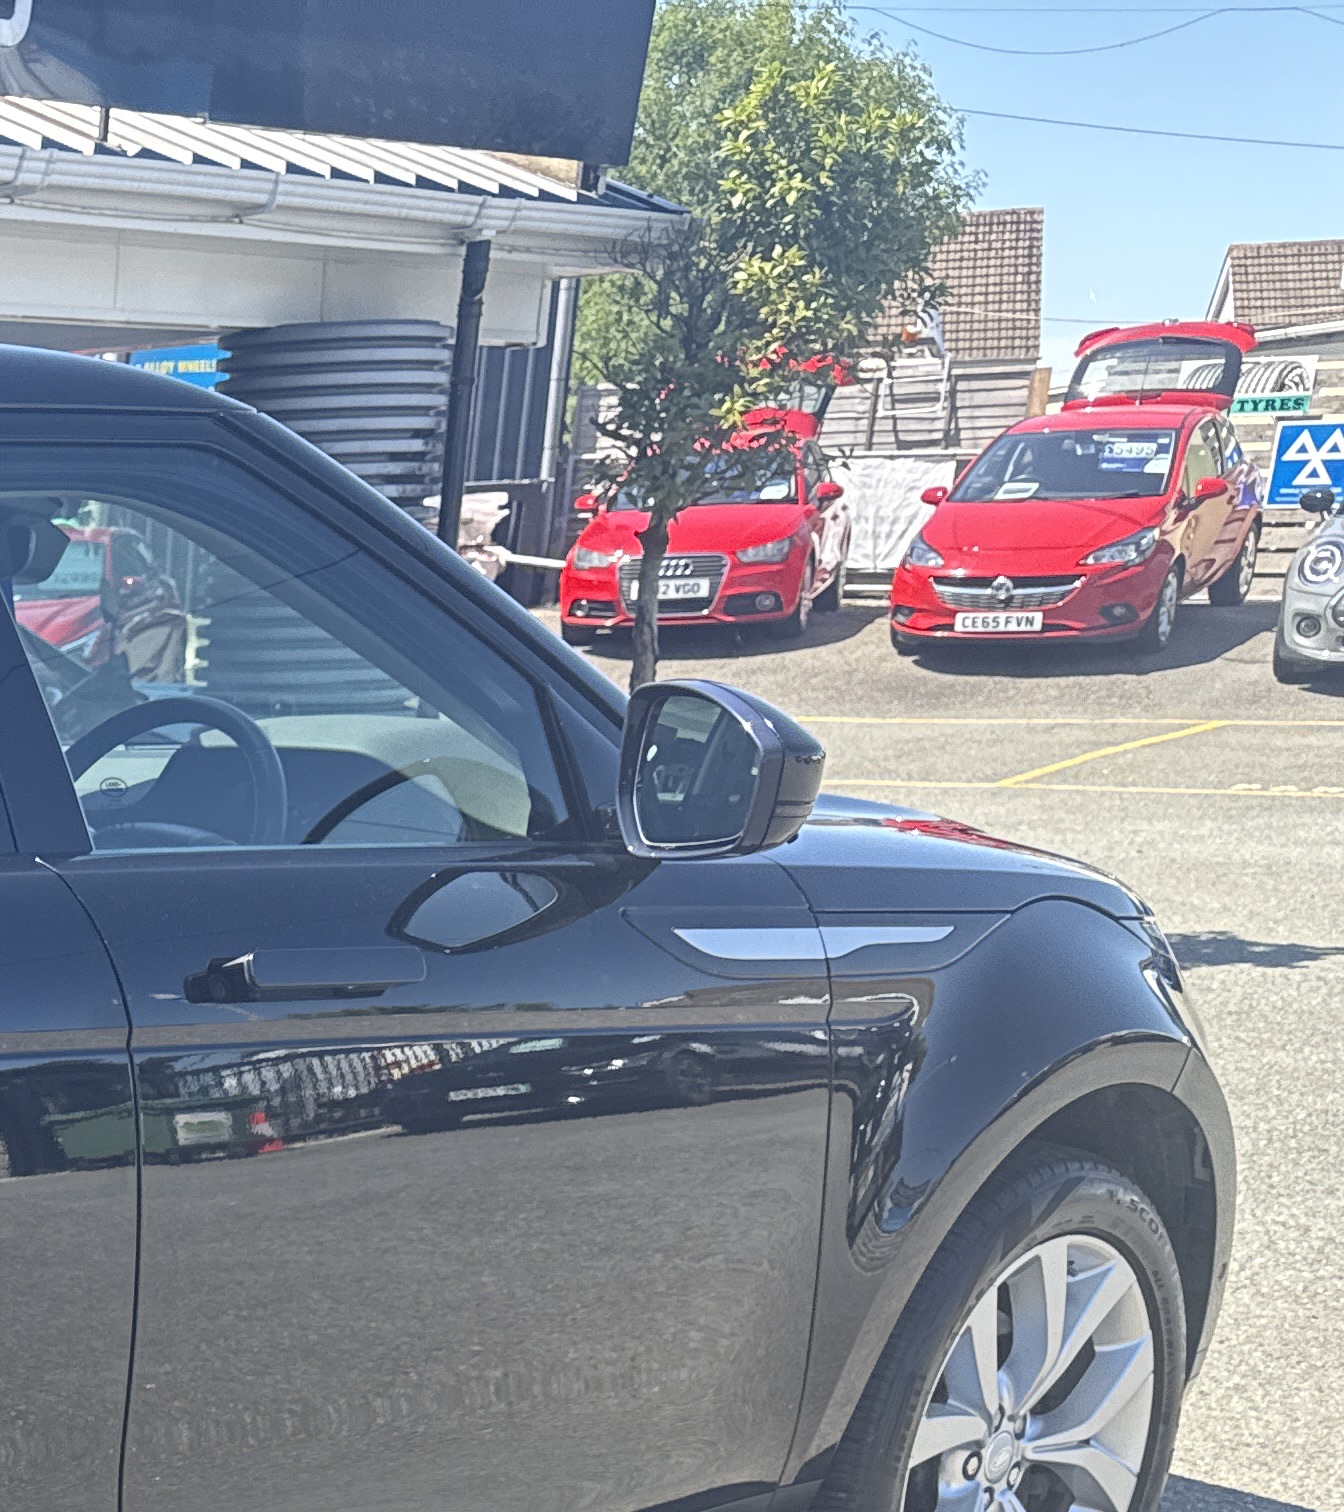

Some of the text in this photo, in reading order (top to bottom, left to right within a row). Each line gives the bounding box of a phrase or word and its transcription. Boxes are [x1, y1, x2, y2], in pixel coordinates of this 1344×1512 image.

[1237, 397, 1305, 412] TYRES
[961, 615, 1035, 629] CE65 FVN
